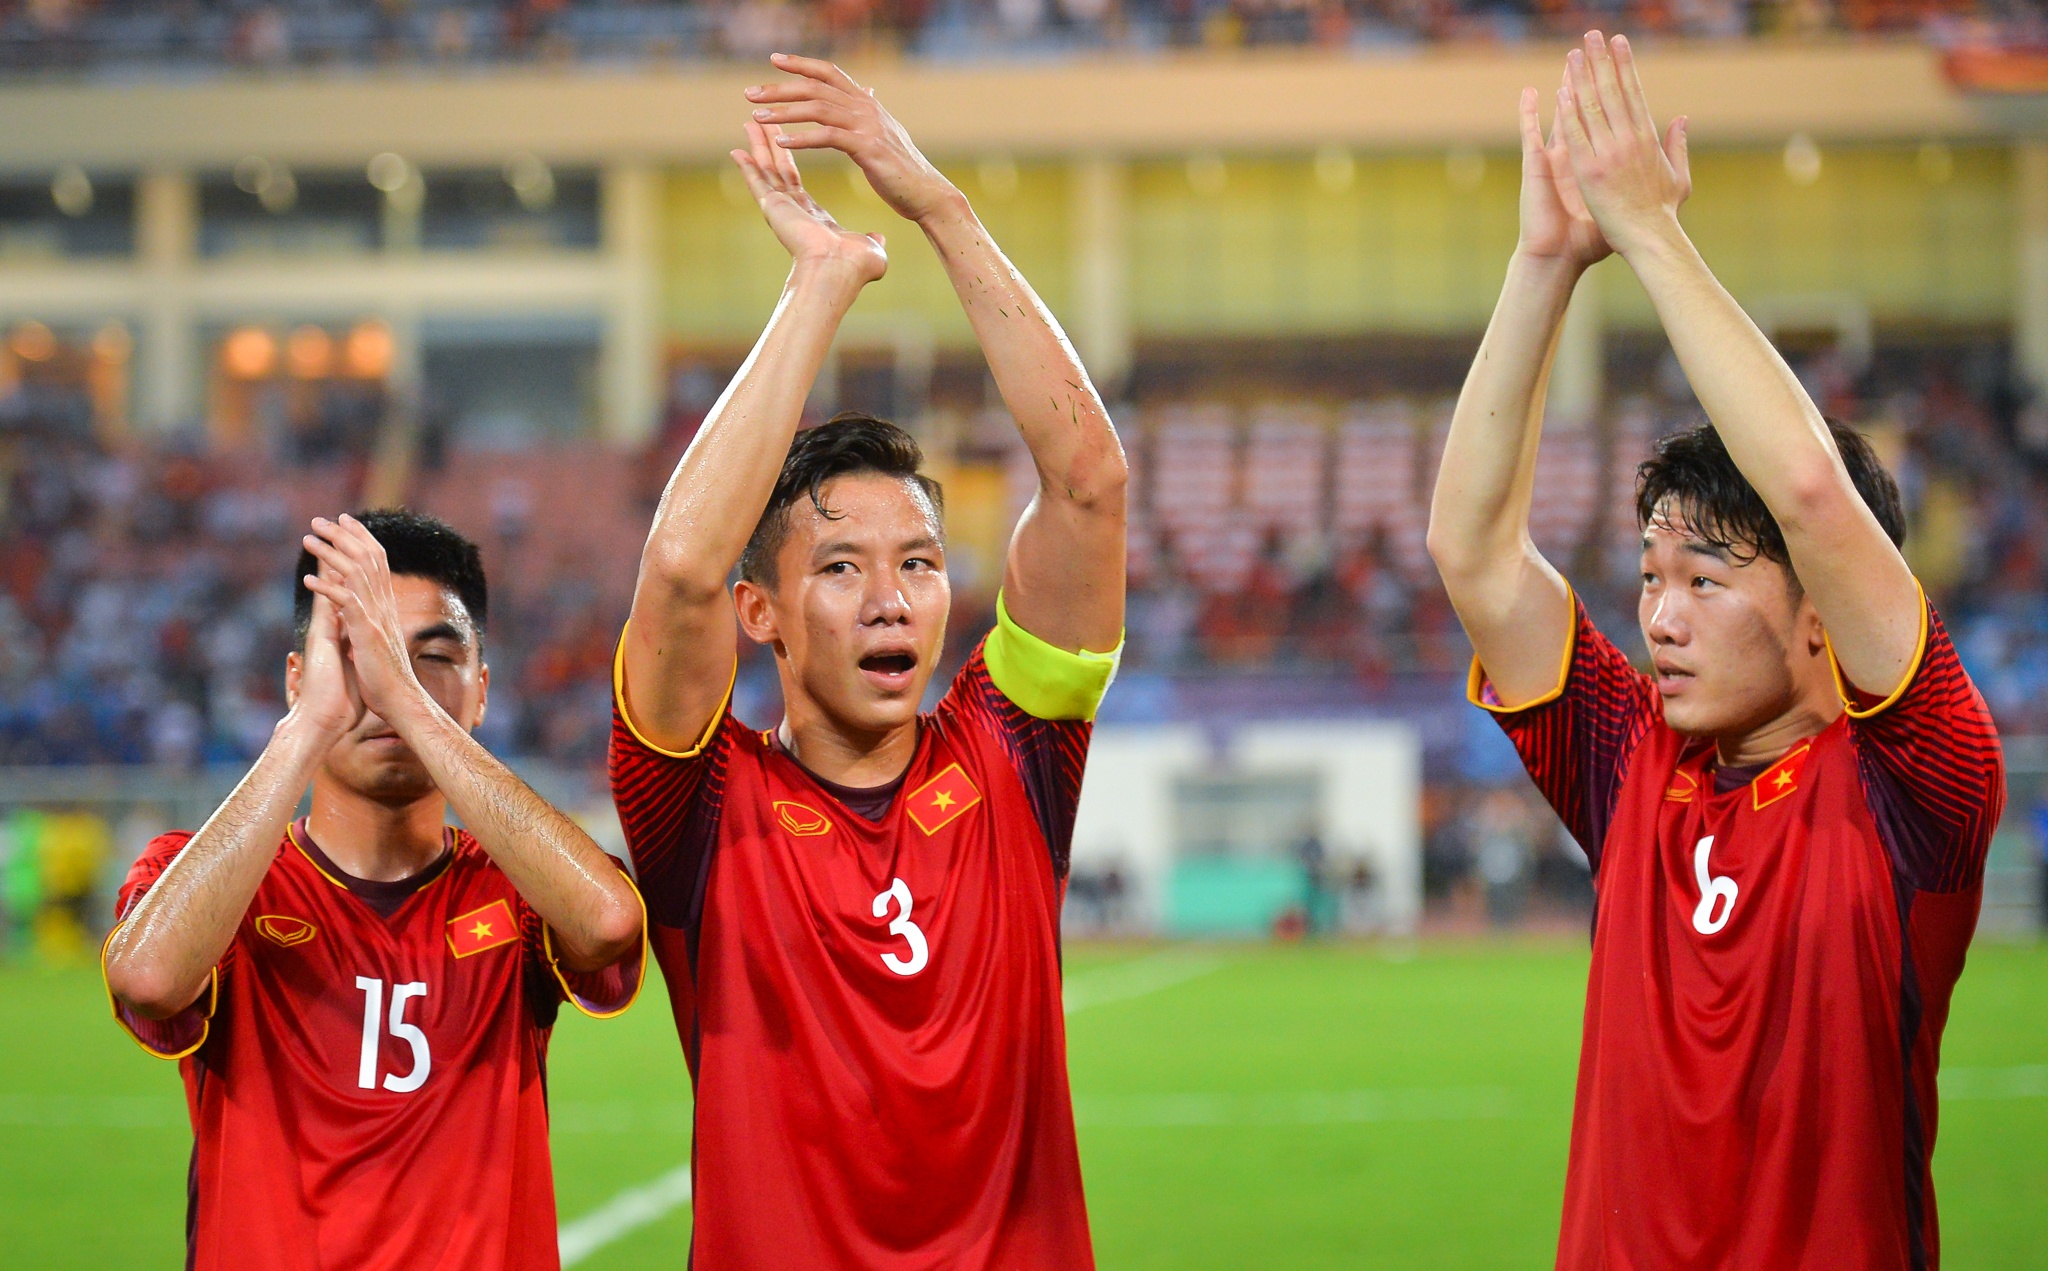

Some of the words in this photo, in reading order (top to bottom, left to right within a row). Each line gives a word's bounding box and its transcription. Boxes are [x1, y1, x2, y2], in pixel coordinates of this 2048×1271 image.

[872, 878, 929, 976] 3
[1692, 835, 1739, 935] 6
[355, 976, 432, 1093] 15
